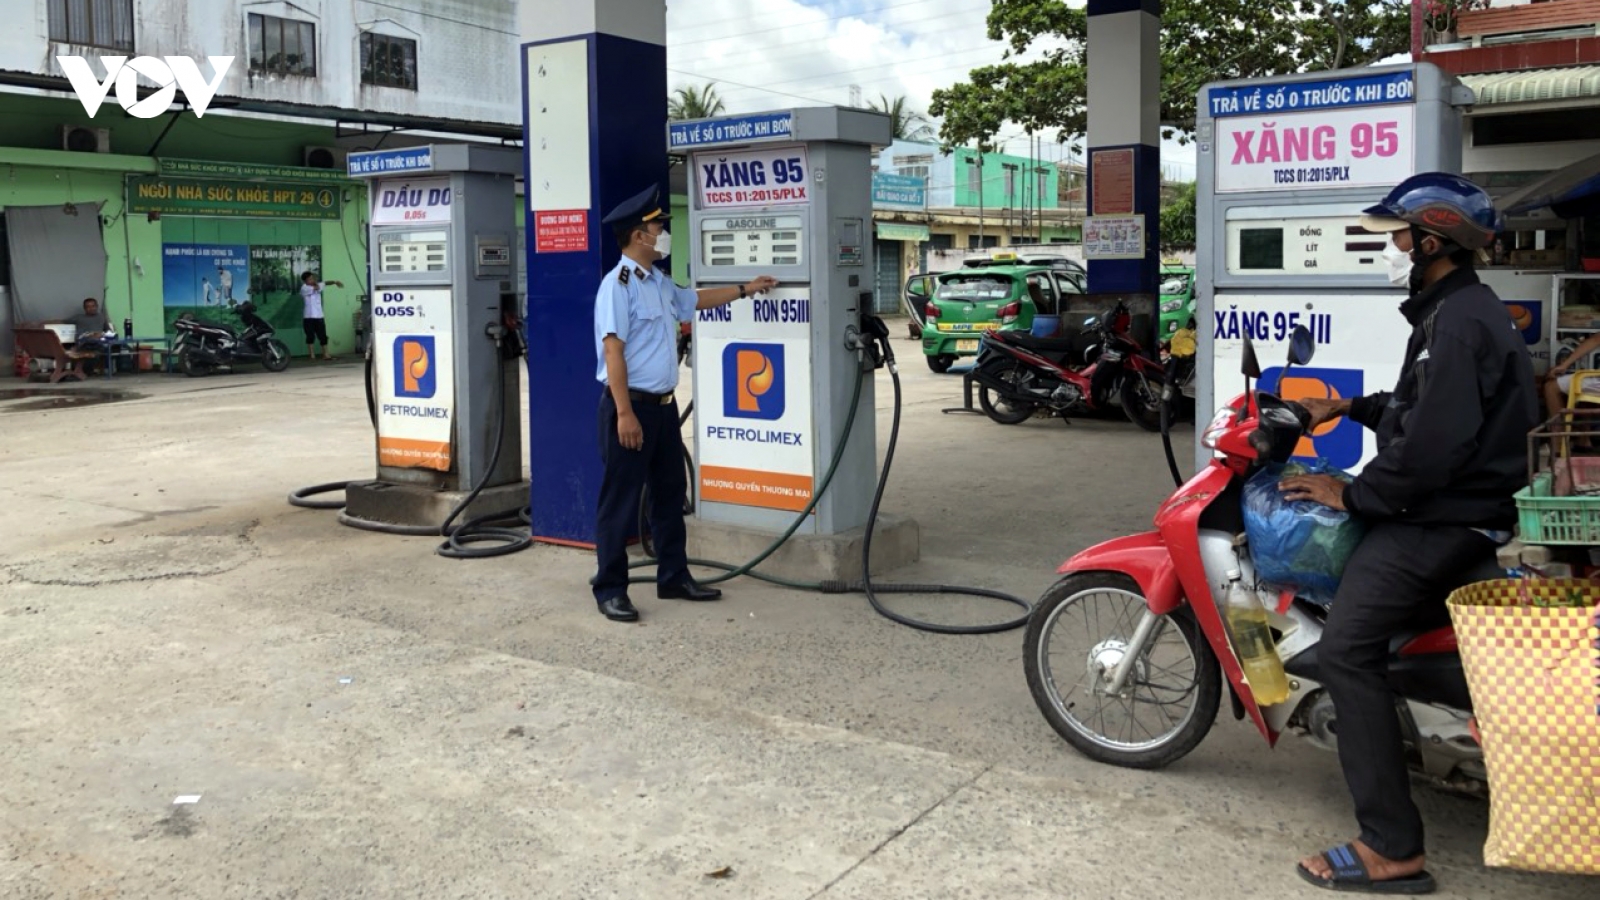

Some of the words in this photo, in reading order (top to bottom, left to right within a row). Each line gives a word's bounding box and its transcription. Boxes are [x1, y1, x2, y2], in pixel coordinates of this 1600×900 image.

[1212, 91, 1239, 114] TRẢ
[1243, 88, 1261, 111] VỀ
[1265, 86, 1286, 109] SỐ
[1302, 83, 1351, 106] TRƯỚC
[1355, 84, 1381, 102] KHI
[671, 126, 688, 145] TRẢ
[689, 124, 701, 144] VỀ
[703, 122, 715, 142] SỐ
[724, 121, 753, 138] TRƯỚC
[754, 121, 770, 136] KHI
[1231, 121, 1336, 165] XĂNG
[1350, 121, 1399, 159] 95
[405, 157, 416, 168] KHI
[702, 157, 766, 189] XĂNG
[772, 157, 804, 184] 95
[1274, 168, 1295, 184] TCCS
[1297, 166, 1350, 183] 01:2015/PLX
[139, 182, 171, 199] NGÔI
[176, 183, 203, 200] NHÀ
[207, 184, 233, 202] SỨC
[236, 184, 270, 203] KHỎE
[273, 190, 296, 204] HPT
[300, 191, 314, 205] 29
[382, 184, 423, 208] DẦU
[706, 191, 733, 203] TCCS
[735, 187, 806, 202] 01:2015/PLX
[726, 218, 776, 229] GASOLINE
[1305, 242, 1318, 252] LÍT
[1304, 258, 1317, 268] GIÁ
[383, 292, 404, 303] DO
[374, 306, 415, 318] 0,05S
[754, 299, 779, 322] RON
[1214, 304, 1270, 341] XĂNG
[383, 404, 449, 419] PETROLIMEX
[707, 426, 802, 446] PETROLIMEX
